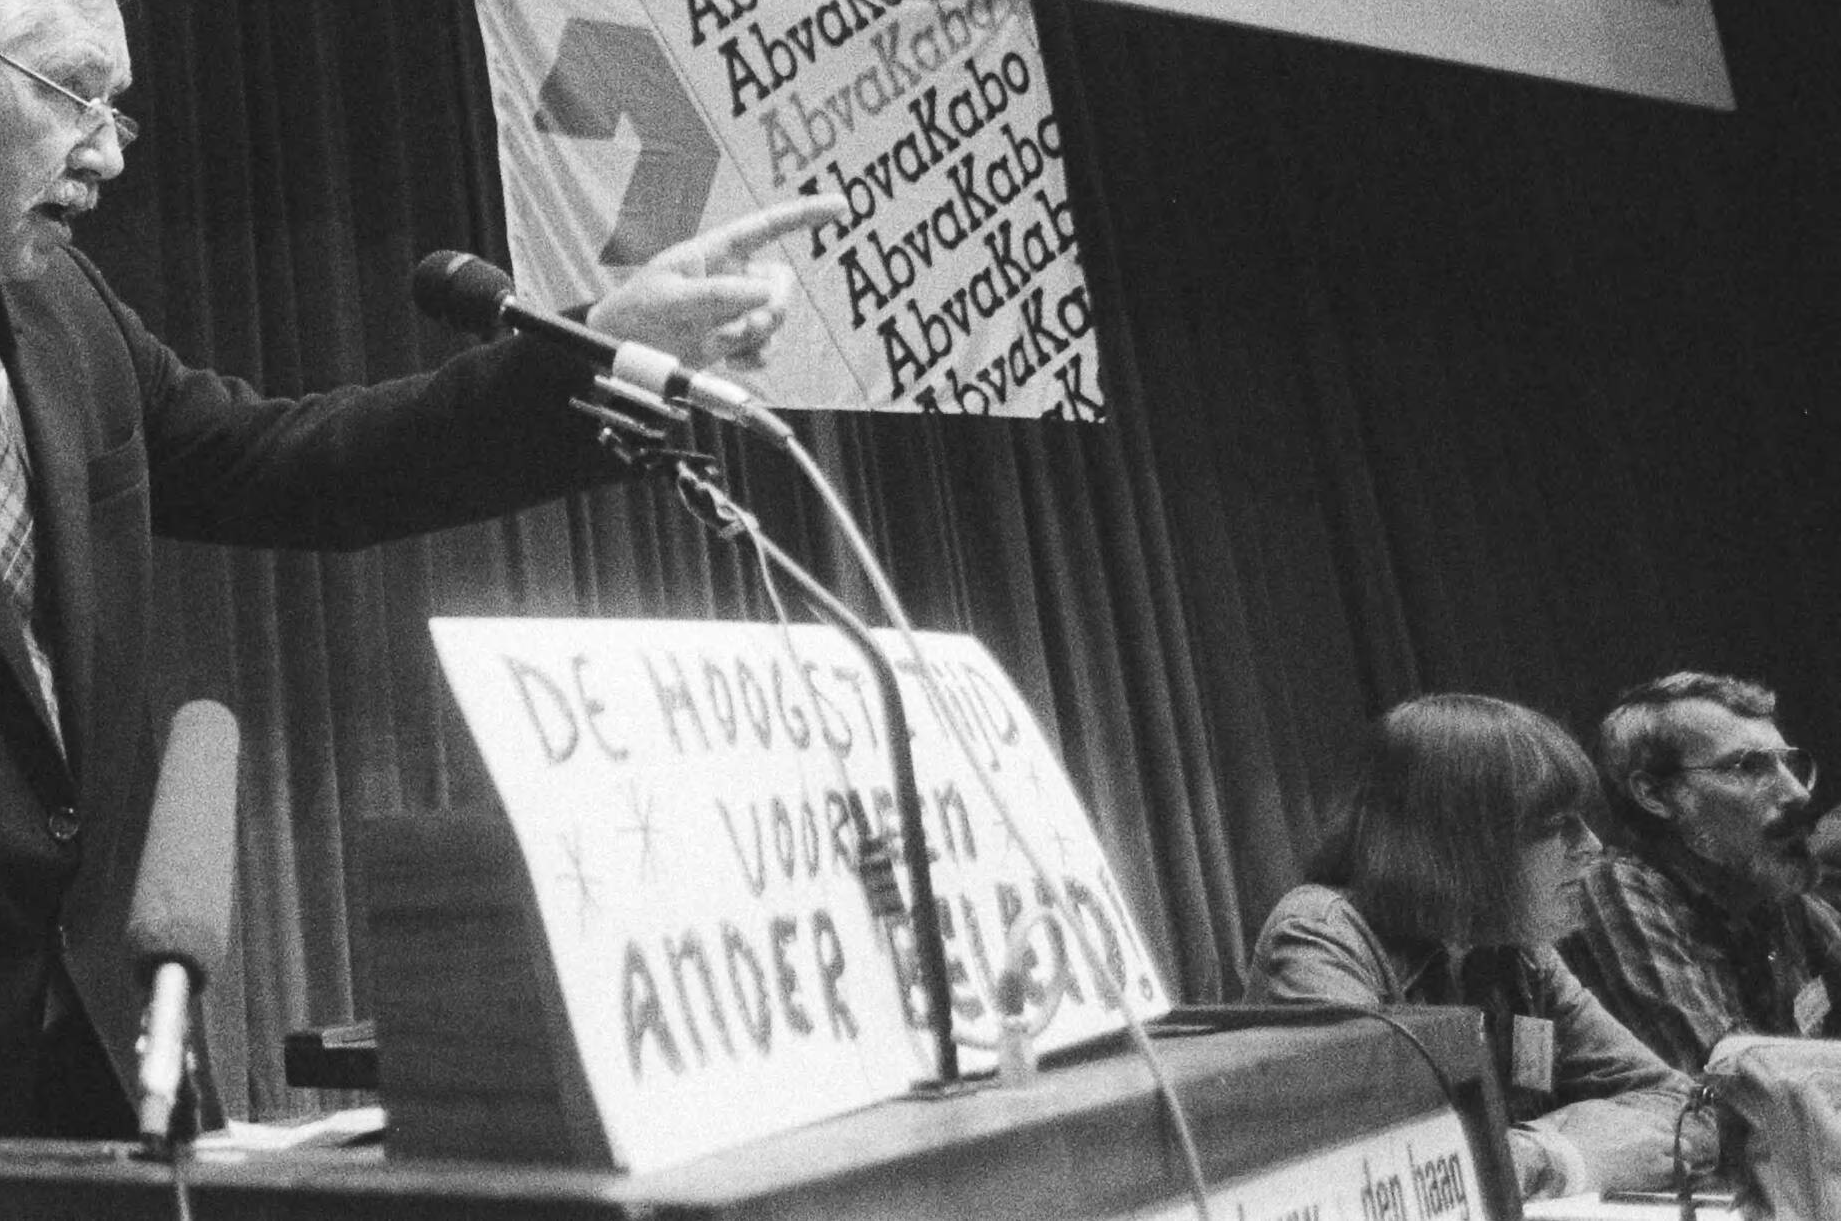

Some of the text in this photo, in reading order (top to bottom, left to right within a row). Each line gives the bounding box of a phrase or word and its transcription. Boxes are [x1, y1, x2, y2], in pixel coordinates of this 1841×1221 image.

[506, 654, 628, 764] DE
[639, 649, 916, 759] HOOGST
[716, 787, 861, 900] VOOR
